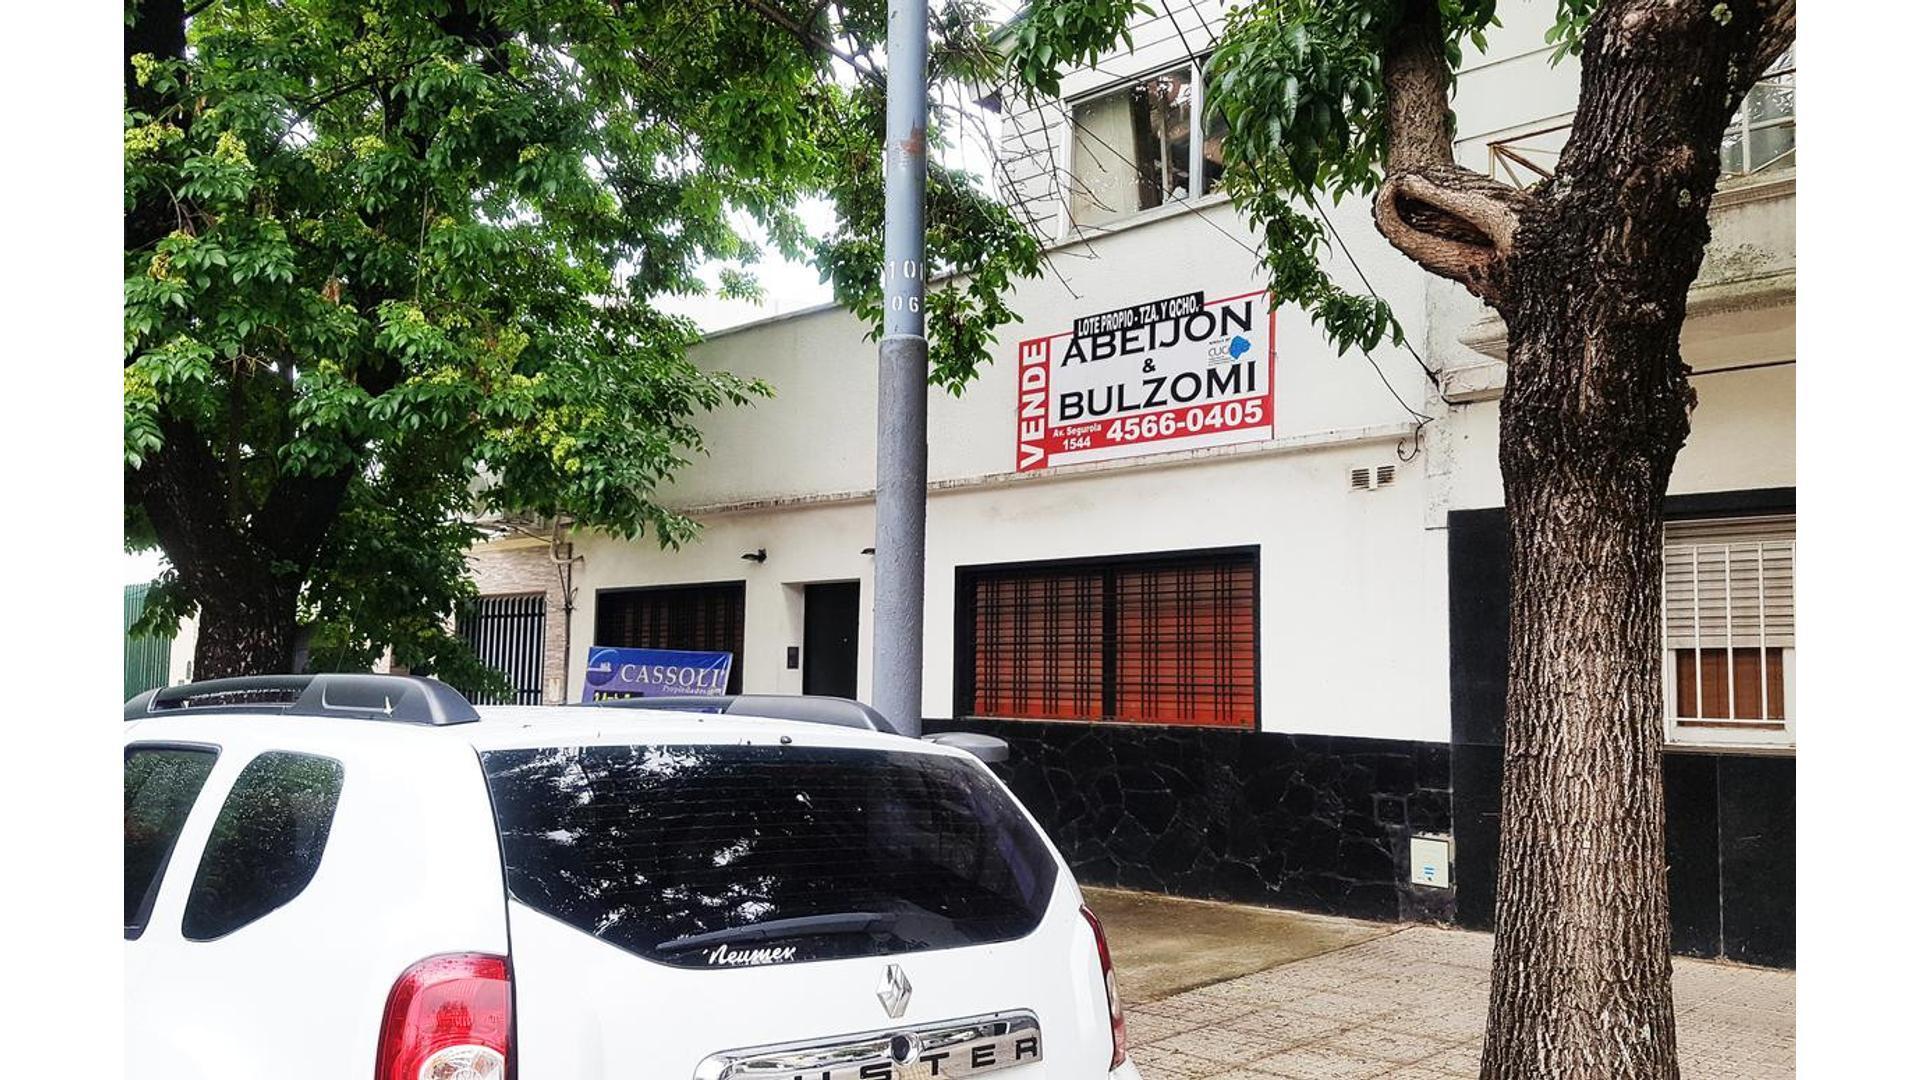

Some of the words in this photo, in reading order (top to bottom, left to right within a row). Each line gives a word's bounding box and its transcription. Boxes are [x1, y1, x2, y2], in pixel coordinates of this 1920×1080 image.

[892, 296, 919, 313] 06
[1078, 315, 1100, 337] LOTE
[1101, 309, 1133, 333] PROPIO
[1140, 304, 1160, 324] TZA.
[1160, 301, 1168, 319] Y
[1142, 358, 1156, 374] &
[1020, 341, 1046, 468] VENDE
[1059, 361, 1256, 421] BULZOMI
[1106, 400, 1264, 442] 4566-0405
[1062, 436, 1091, 451] 1544
[621, 664, 721, 687] CASSOLI
